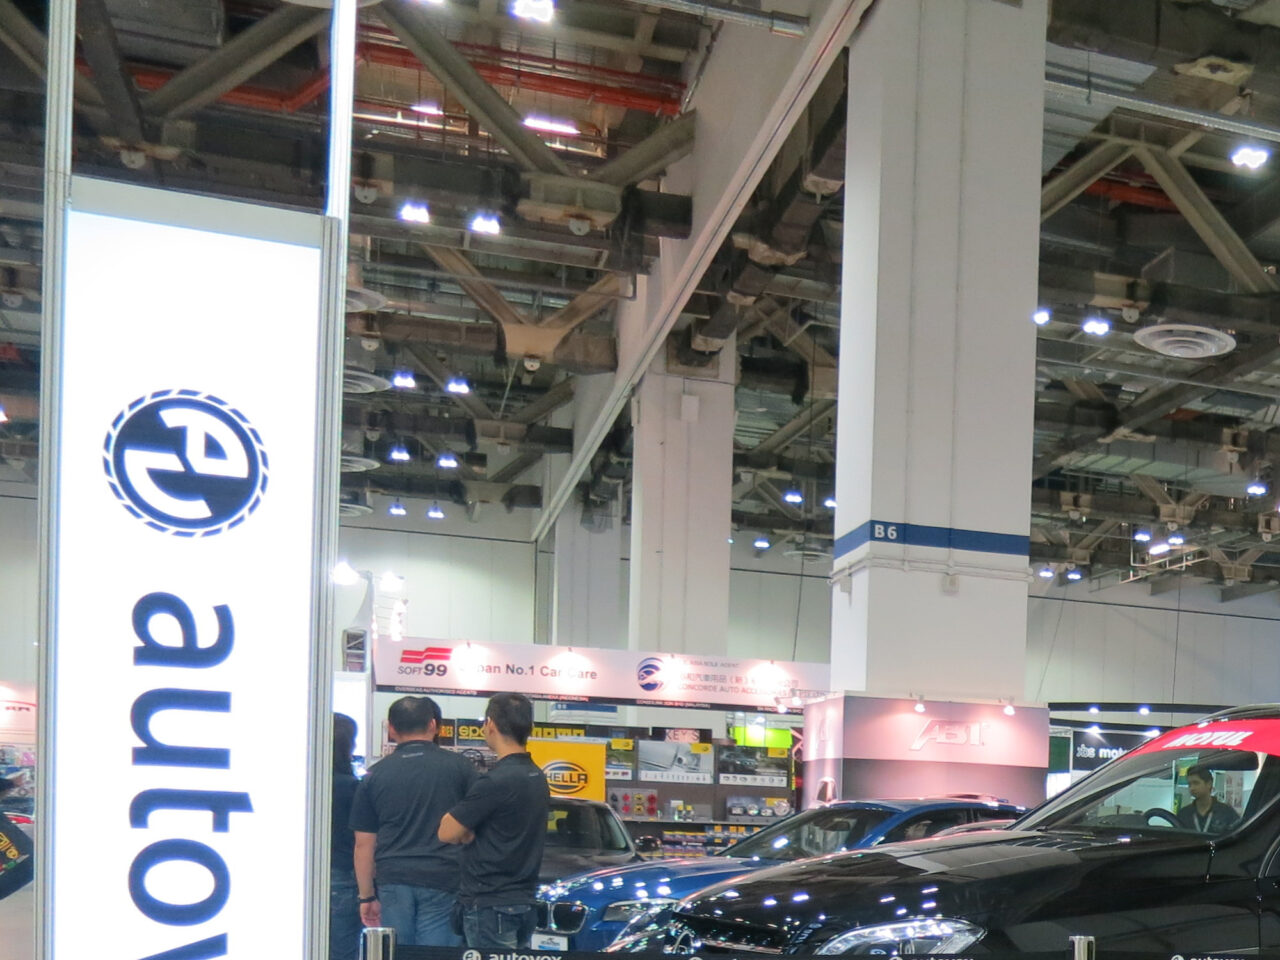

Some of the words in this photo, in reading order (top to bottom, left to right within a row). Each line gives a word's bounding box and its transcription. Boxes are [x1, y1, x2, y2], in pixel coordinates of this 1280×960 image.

[505, 664, 535, 676] No.1
[1162, 731, 1255, 749] MOTUL
[546, 772, 588, 784] HELLA
